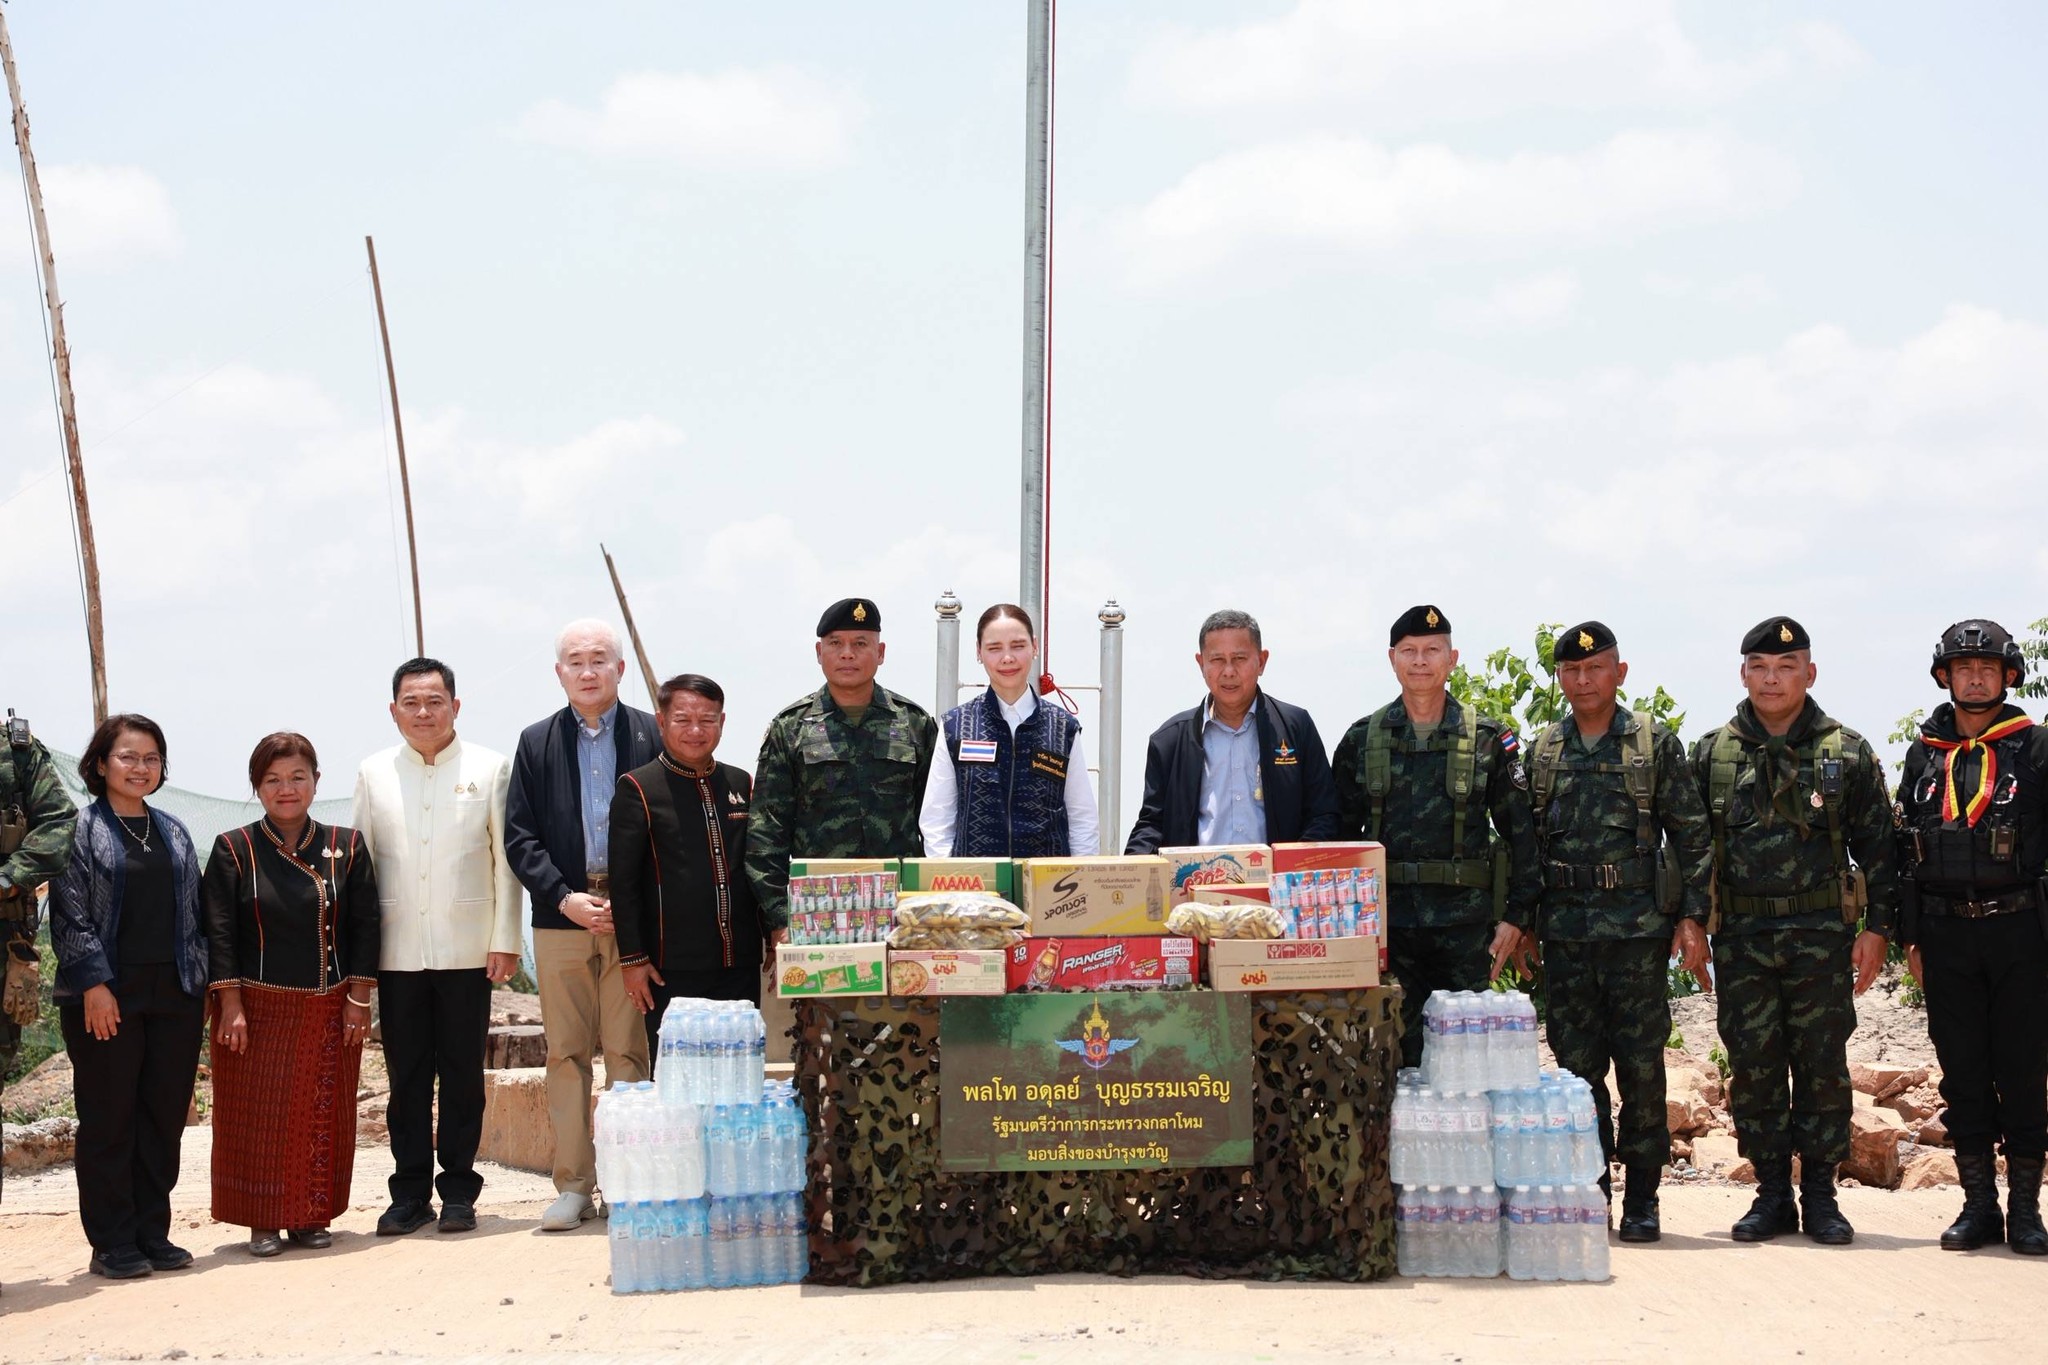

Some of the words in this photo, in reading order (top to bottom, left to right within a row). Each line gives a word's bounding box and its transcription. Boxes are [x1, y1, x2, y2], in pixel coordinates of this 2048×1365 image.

[931, 875, 983, 890] MAMA
[1044, 896, 1087, 920] SPONSOR
[1014, 946, 1027, 958] 10
[1062, 944, 1123, 975] RANGER
[962, 1077, 1016, 1101] พลโท
[1026, 1075, 1080, 1107] อดุลย์
[1096, 1074, 1230, 1106] บุญธรรมเจริญ
[992, 1112, 1203, 1138] รัฐมนตรีว่าการกระทรวงกลาโหม
[1027, 1141, 1168, 1165] มอบสิ่งของบำรุงขวัญ
